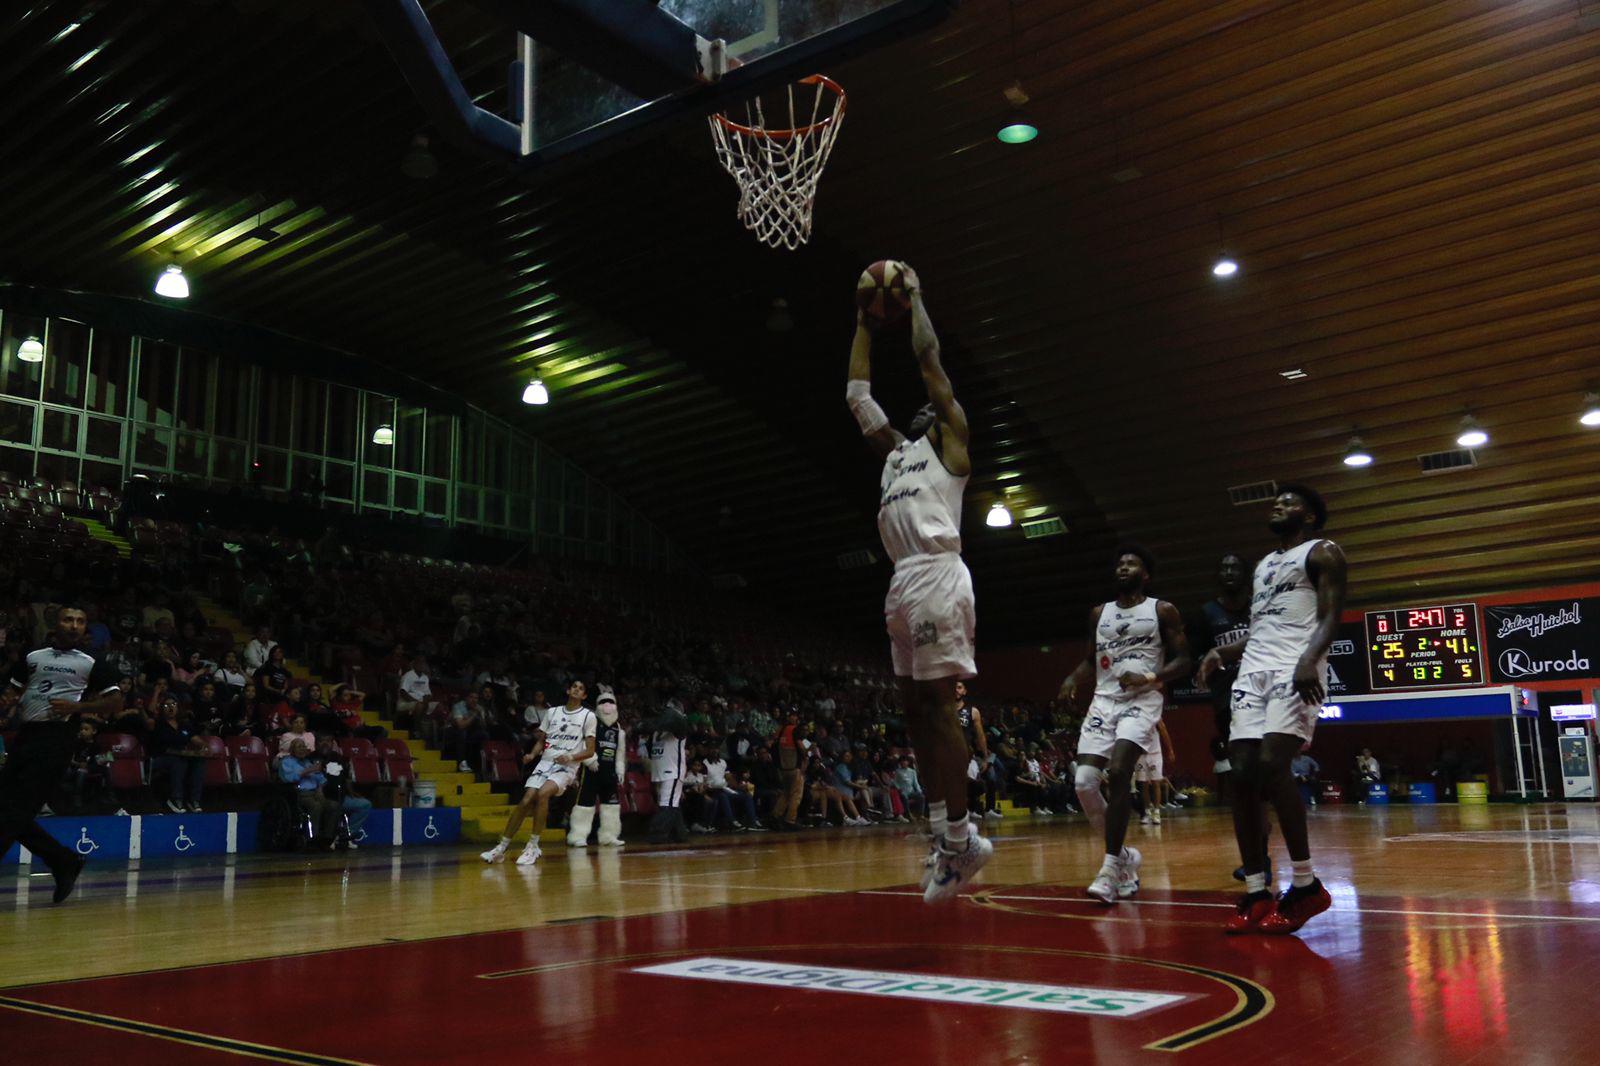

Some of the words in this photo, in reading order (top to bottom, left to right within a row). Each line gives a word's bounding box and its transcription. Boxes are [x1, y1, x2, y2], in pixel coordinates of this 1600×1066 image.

[1408, 609, 1443, 628] 2:47
[1455, 614, 1465, 627] 2
[1496, 614, 1531, 639] Salsa
[1527, 602, 1582, 638] Huichol
[1378, 620, 1388, 632] 0
[1440, 628, 1467, 637] HOME
[1376, 633, 1405, 642] GUEST
[1417, 637, 1428, 650] 2
[1383, 642, 1405, 659] 25
[1445, 637, 1469, 654] 41
[1410, 651, 1437, 659] PERIOD
[1503, 649, 1590, 676] Kuroda
[1384, 669, 1395, 682] 4
[1432, 666, 1443, 679] 2
[1461, 664, 1473, 679] 5
